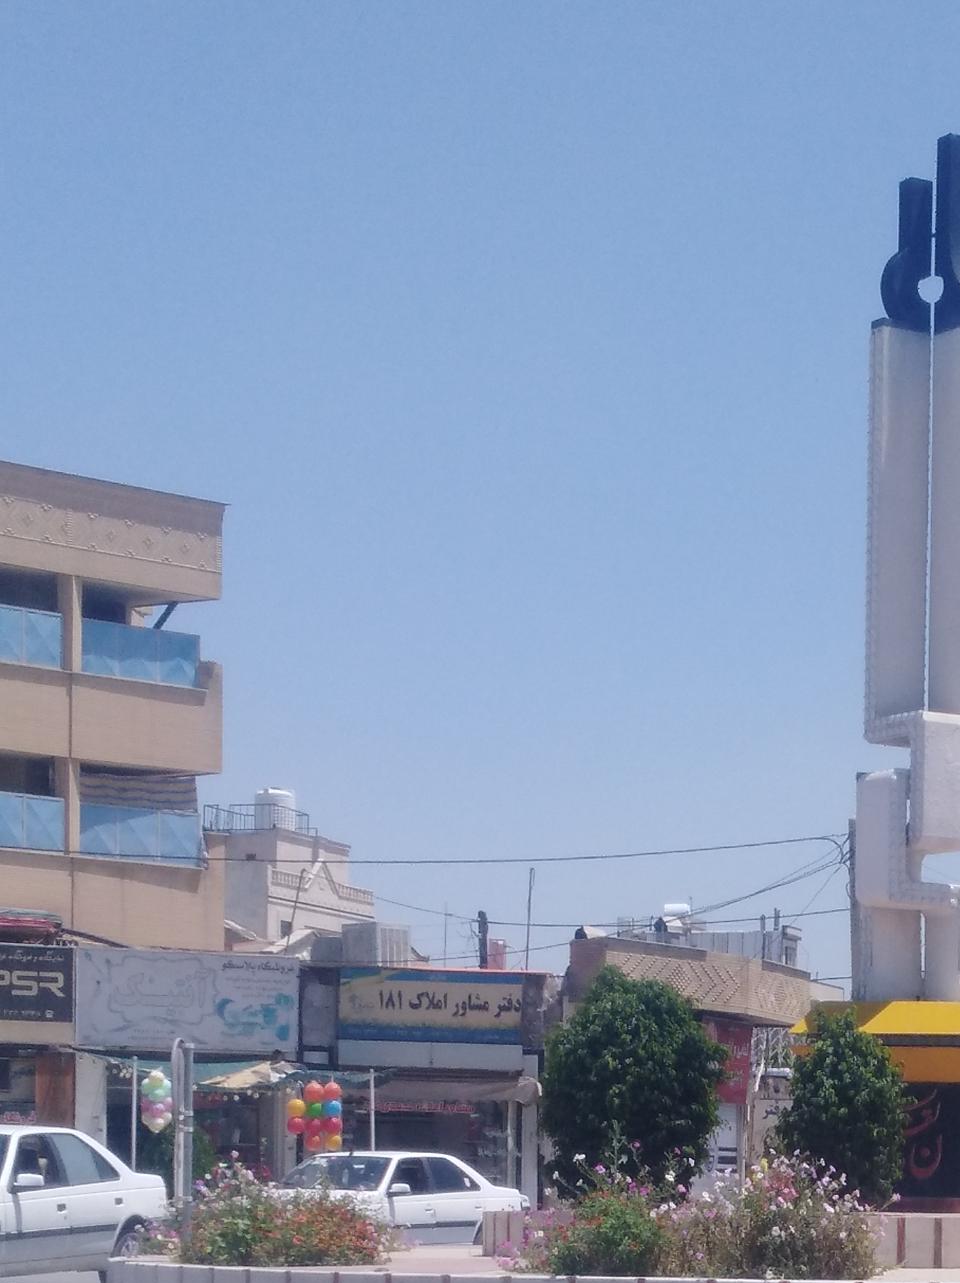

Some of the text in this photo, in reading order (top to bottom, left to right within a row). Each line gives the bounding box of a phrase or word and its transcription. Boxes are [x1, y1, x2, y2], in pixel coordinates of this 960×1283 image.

[408, 990, 448, 1011] املاک
[451, 993, 490, 1018] مشاور
[494, 992, 522, 1019] دفتر
